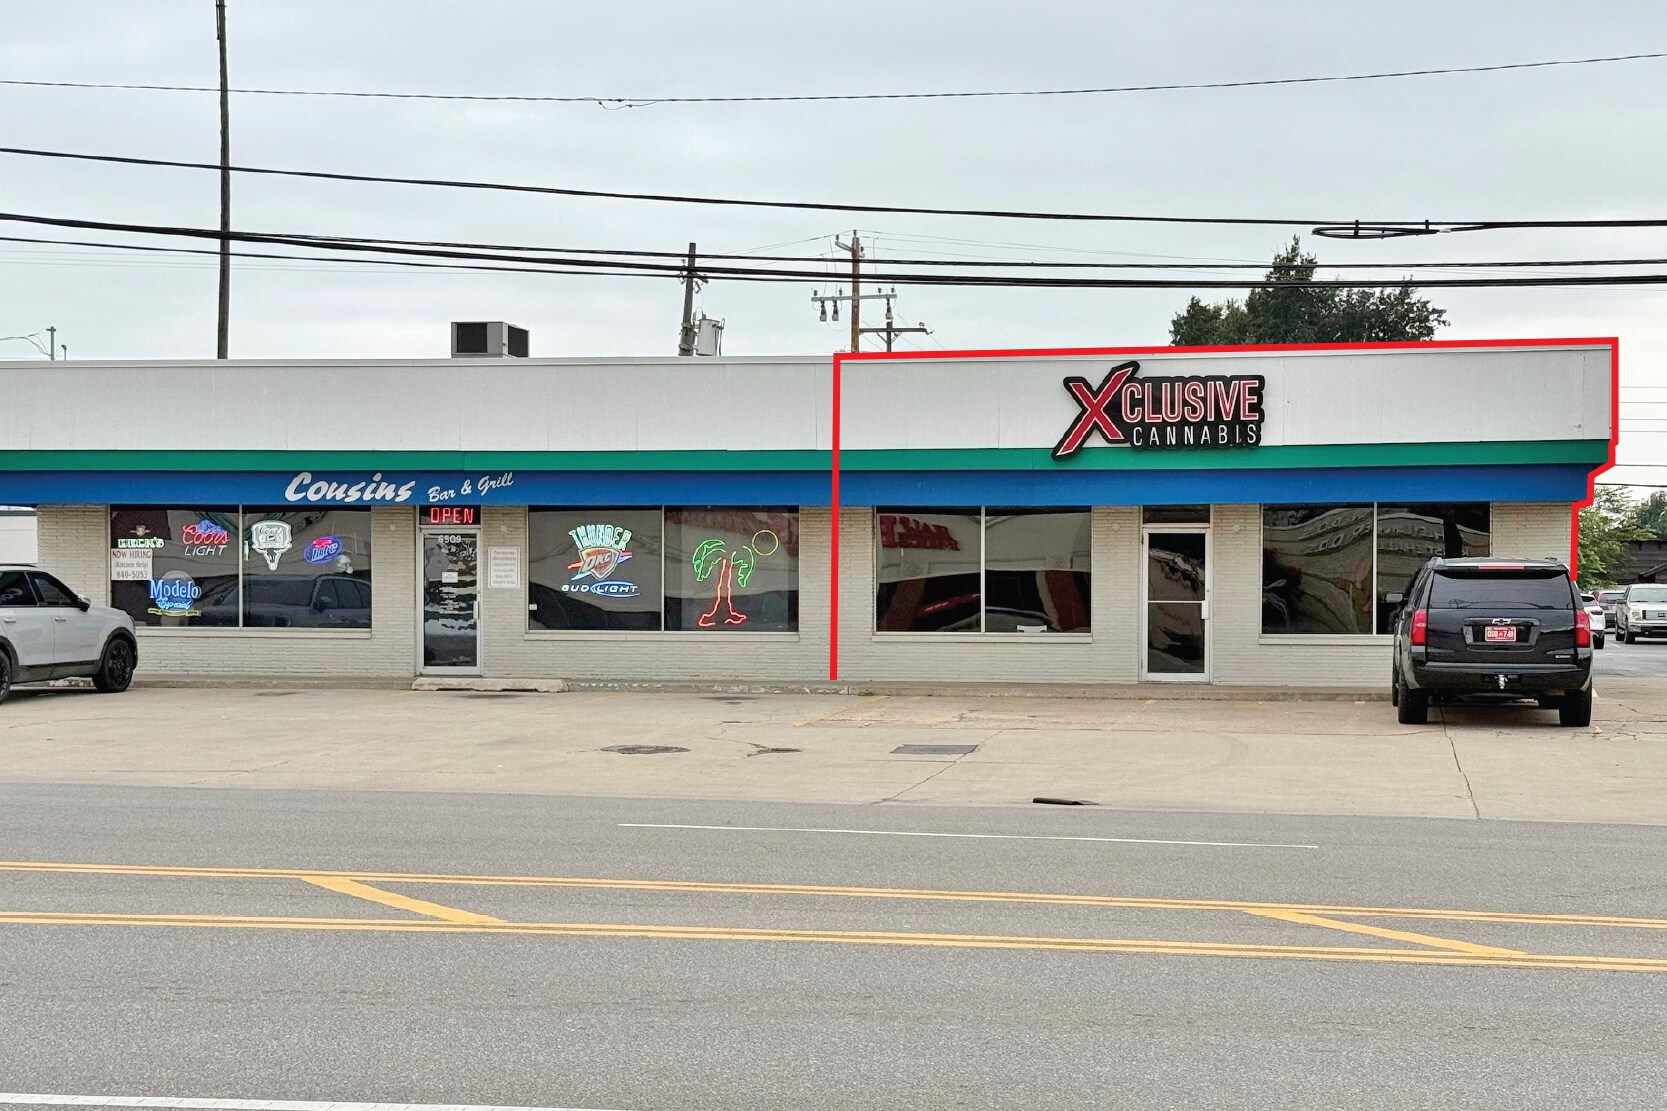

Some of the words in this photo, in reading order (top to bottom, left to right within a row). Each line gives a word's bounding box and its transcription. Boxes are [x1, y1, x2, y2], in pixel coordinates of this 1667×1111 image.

[1056, 367, 1260, 456] XCLUSIVE
[1132, 424, 1257, 446] CANNABIS
[285, 472, 416, 503] Cousins
[427, 486, 456, 502] Bar
[460, 479, 472, 495] &
[477, 472, 514, 496] Grill
[430, 507, 474, 524] OPEN
[182, 524, 230, 545] Coors
[568, 525, 632, 551] THUNDER
[112, 551, 127, 559] NOW
[130, 551, 151, 559] HIRING
[184, 545, 227, 556] LIGHT
[149, 579, 202, 600] Modelo
[561, 584, 589, 593] BUD
[597, 585, 638, 593] LIGHT
